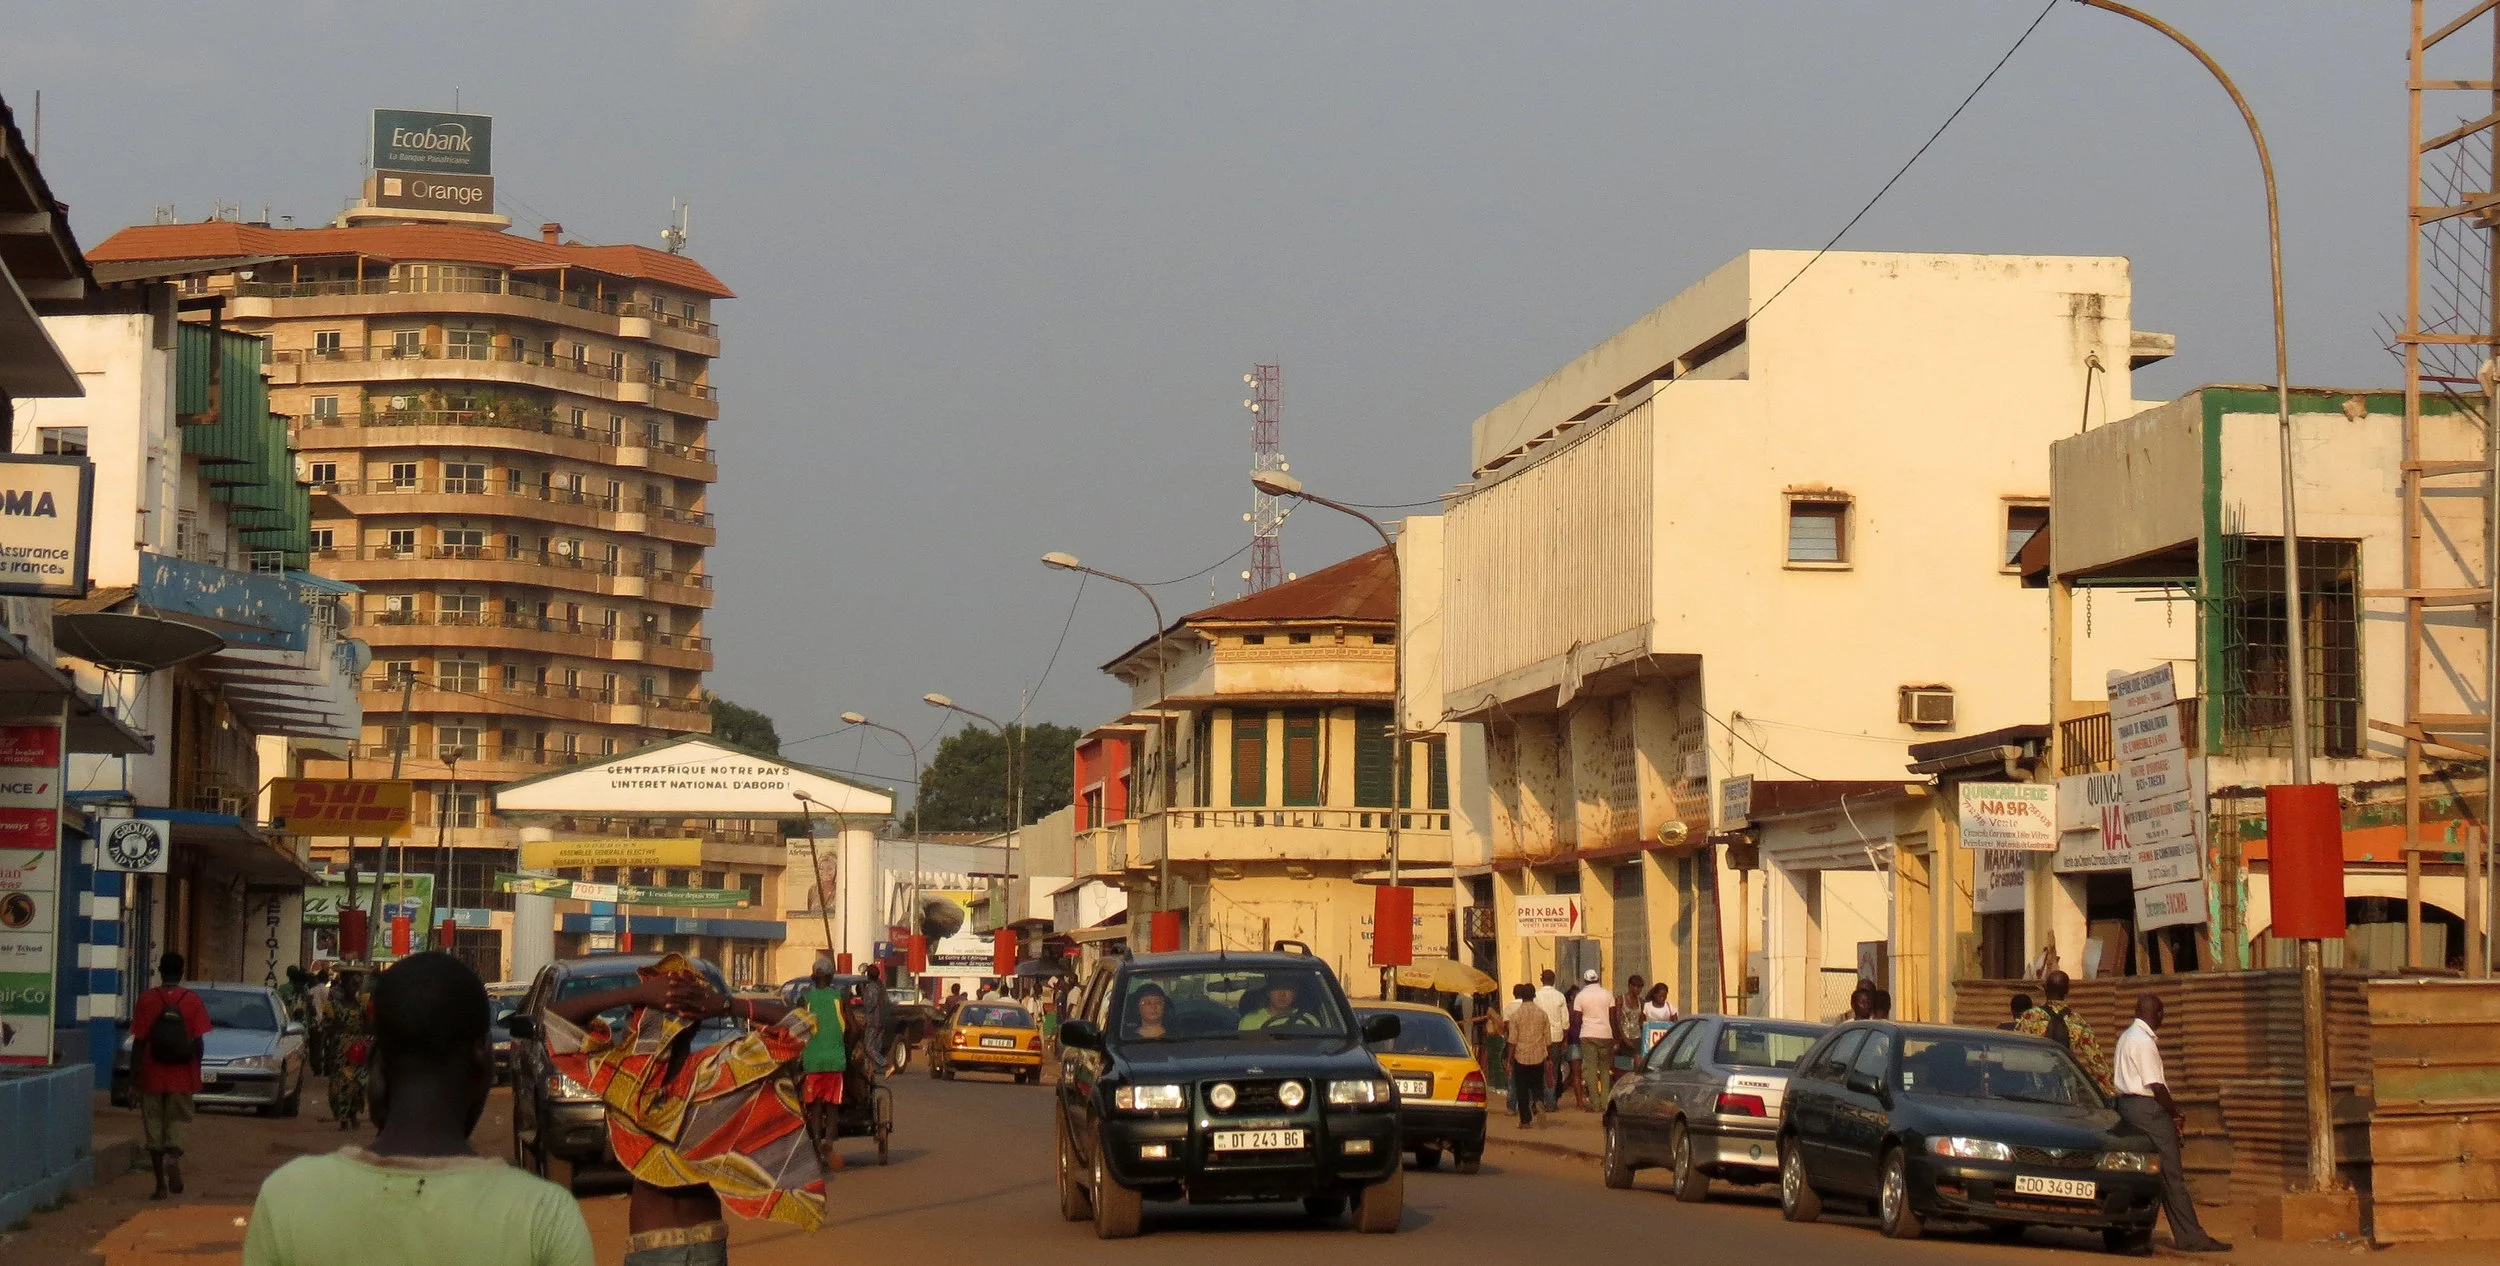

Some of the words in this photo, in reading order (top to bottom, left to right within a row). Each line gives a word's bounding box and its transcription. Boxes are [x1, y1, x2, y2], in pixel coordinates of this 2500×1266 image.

[392, 126, 473, 151] Ecobank
[412, 180, 483, 205] Orange
[608, 766, 706, 775] CENTRAFRIQUE
[710, 766, 753, 775] NOTRE
[757, 767, 790, 776] PAYS
[612, 780, 667, 789] L'INTERET
[670, 780, 728, 790] NATIONAL
[292, 782, 391, 820] DHL
[1980, 800, 2029, 817] NASR
[114, 823, 155, 840] GROUPE
[110, 847, 159, 868] PAPYRUS
[574, 884, 595, 894] 700
[1232, 1133, 1246, 1148] DT
[1253, 1132, 1277, 1148] 243
[1284, 1131, 1299, 1147] BG
[2047, 1180, 2073, 1195] 349
[2076, 1183, 2093, 1197] BG
